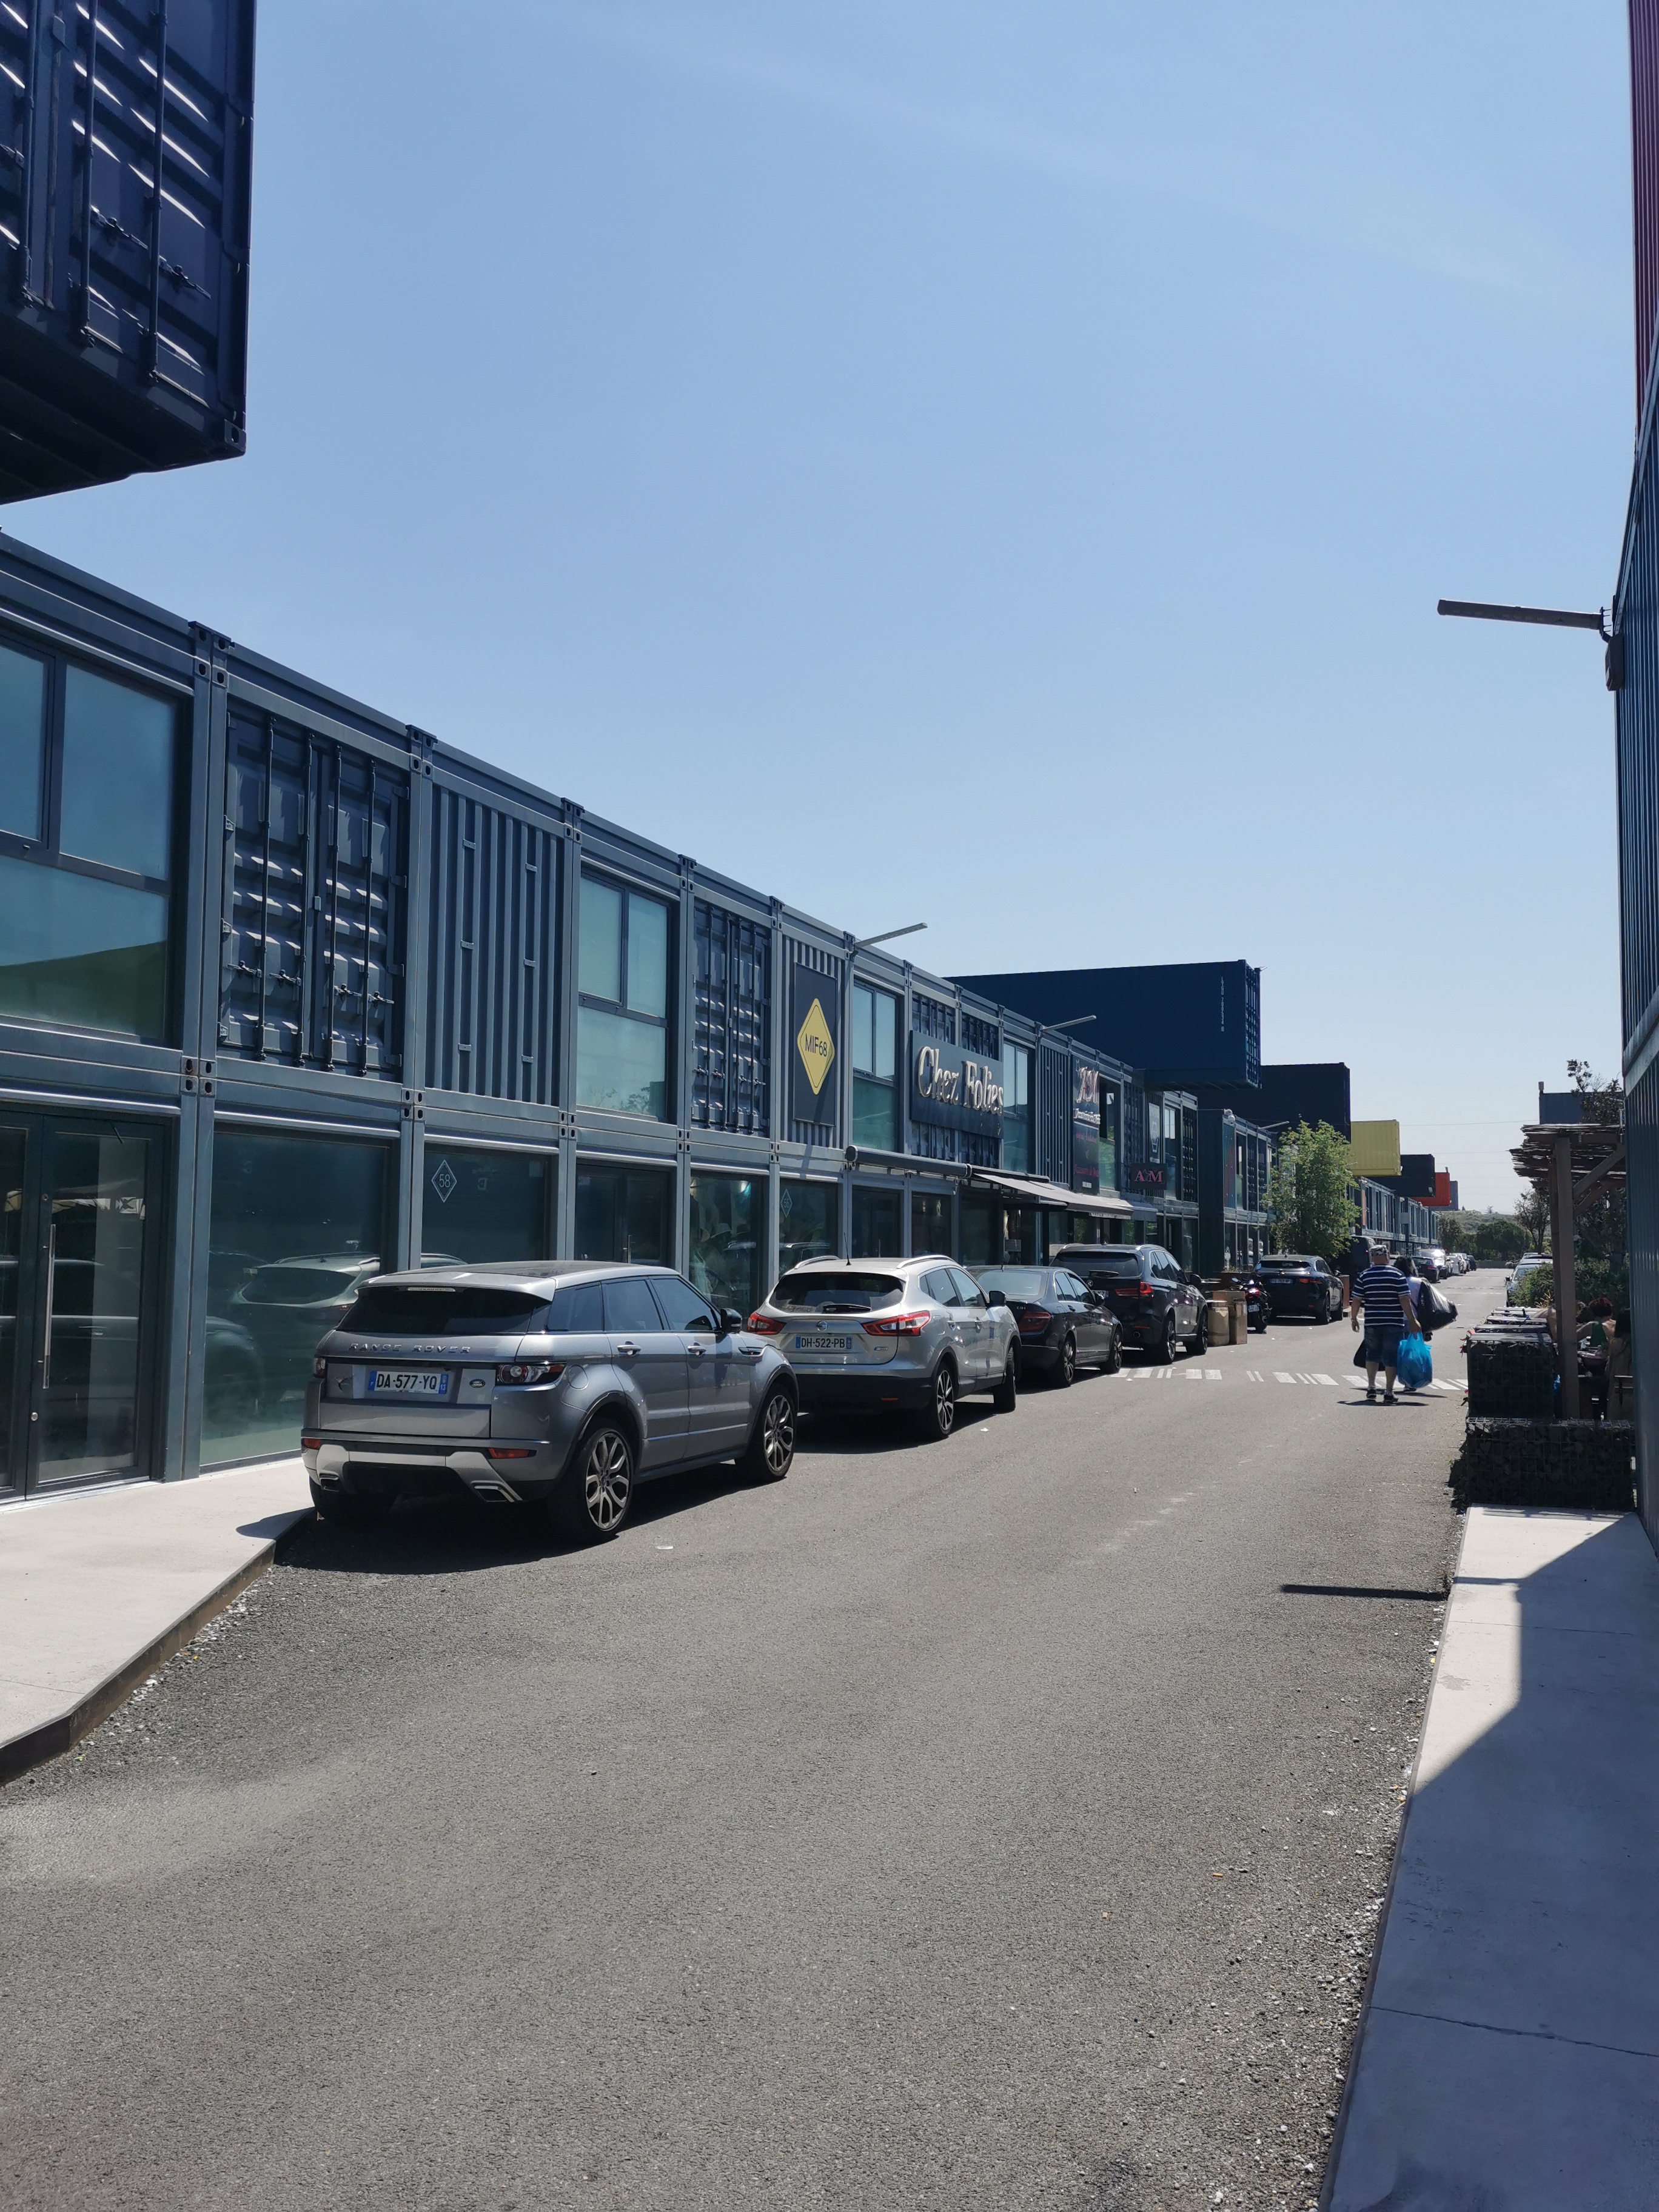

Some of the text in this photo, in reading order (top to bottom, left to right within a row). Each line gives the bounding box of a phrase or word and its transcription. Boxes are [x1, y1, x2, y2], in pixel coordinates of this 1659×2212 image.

[805, 1033, 827, 1057] MIF68
[918, 1046, 1004, 1116] Chez Folies
[439, 1173, 451, 1188] 58
[349, 1343, 471, 1354] RANGE ROVER
[801, 1338, 845, 1349] DH-522-PB
[376, 1373, 438, 1390] DA-577-YQ
